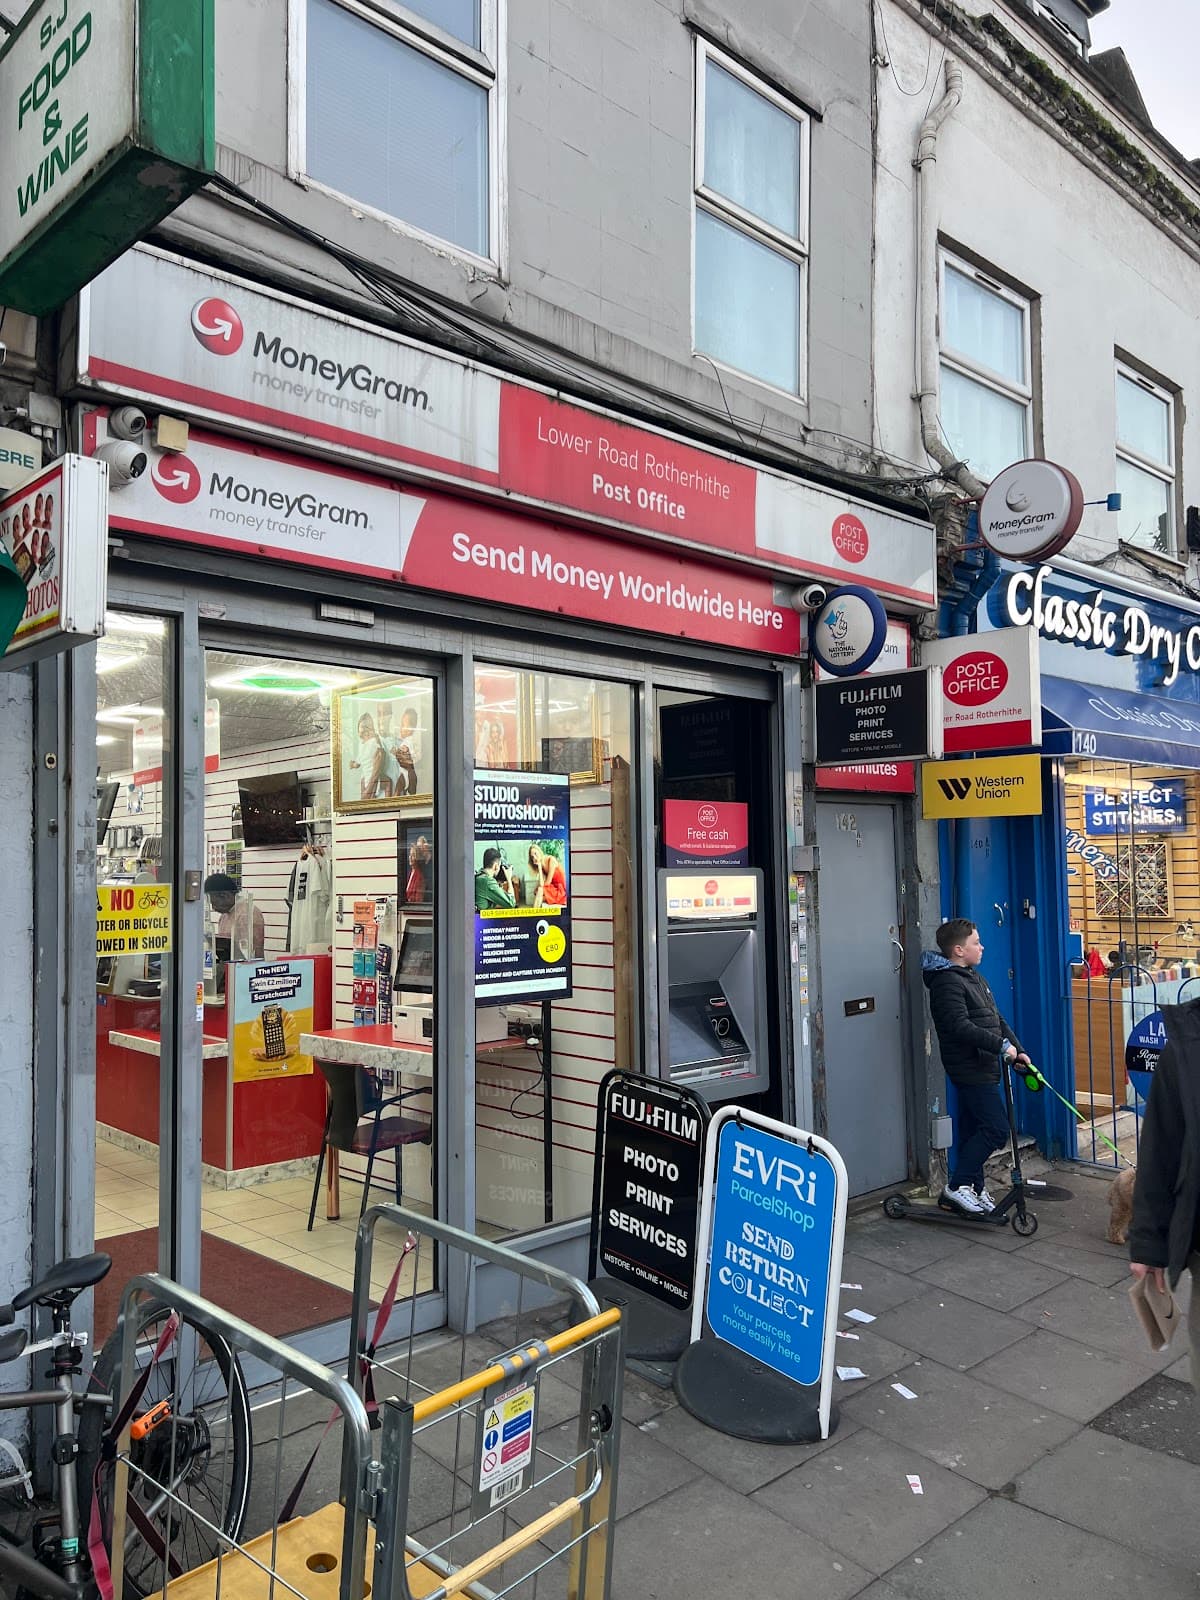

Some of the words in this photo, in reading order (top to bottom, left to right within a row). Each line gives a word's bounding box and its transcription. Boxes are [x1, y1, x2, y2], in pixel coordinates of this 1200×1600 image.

[18, 11, 92, 131] FOOD
[42, 98, 62, 146] &
[17, 112, 89, 217] WINE
[253, 330, 431, 411] MoneyGram
[251, 368, 313, 400] money
[315, 385, 382, 419] transfer
[537, 416, 592, 455] Lower
[599, 438, 639, 471] Road
[644, 452, 731, 500] Rotherhithe
[209, 472, 370, 529] MoneyGram
[593, 474, 631, 503] Post
[637, 490, 686, 520] Office
[209, 506, 264, 527] money
[266, 517, 326, 542] transfer
[838, 522, 863, 539] POST
[990, 512, 1055, 531] MoneyGram
[835, 537, 865, 556] OFFICE
[26, 576, 58, 619] HOTOS
[452, 534, 525, 574] Send
[531, 552, 614, 597] Money
[619, 572, 734, 618] Worldwide
[737, 600, 783, 630] Here
[1007, 565, 1116, 648] Classic
[1123, 607, 1180, 685] Dry
[948, 675, 1000, 695] OFFICE
[956, 661, 994, 679] POST
[840, 685, 902, 704] FUJIFILM
[856, 705, 886, 716] PHOTO
[857, 718, 885, 728] PRINT
[955, 712, 974, 721] Road
[976, 707, 1022, 719] Rotherhithe
[849, 730, 893, 741] SERVICES
[1077, 732, 1097, 754] 140
[474, 785, 520, 802] STUDIO
[975, 775, 1024, 788] Western
[975, 787, 1010, 799] Union
[1094, 788, 1173, 806] PERFECT
[474, 803, 555, 821] PHOTOSHOOT
[1092, 809, 1176, 826] STITCHES
[687, 828, 706, 840] Free
[709, 828, 728, 840] cash
[1066, 827, 1119, 878] ners
[111, 888, 135, 912] NO
[119, 919, 130, 930] OR
[133, 917, 168, 930] BICYCLE
[96, 938, 125, 952] OWED
[128, 937, 138, 950] IN
[142, 936, 168, 949] SHOP
[254, 989, 293, 1000] Scratchcard
[1139, 1036, 1159, 1045] WASH
[611, 1092, 698, 1142] FUJIFILM
[623, 1145, 679, 1182] PHOTO
[732, 1140, 817, 1206] EVRi
[626, 1181, 674, 1216] PRINT
[731, 1180, 815, 1232] ParcelShop
[609, 1208, 688, 1258] SERVICES
[742, 1221, 795, 1261] SEND
[604, 1253, 631, 1271] INSTORE
[635, 1268, 659, 1285] ONLINE
[664, 1281, 688, 1300] MOBILE
[724, 1240, 811, 1299] RETURN
[718, 1266, 814, 1328] COLLECT
[722, 1314, 747, 1333] more
[748, 1329, 776, 1352] easily
[778, 1342, 801, 1363] here
[733, 1304, 754, 1323] Your
[755, 1318, 791, 1343] parcels
